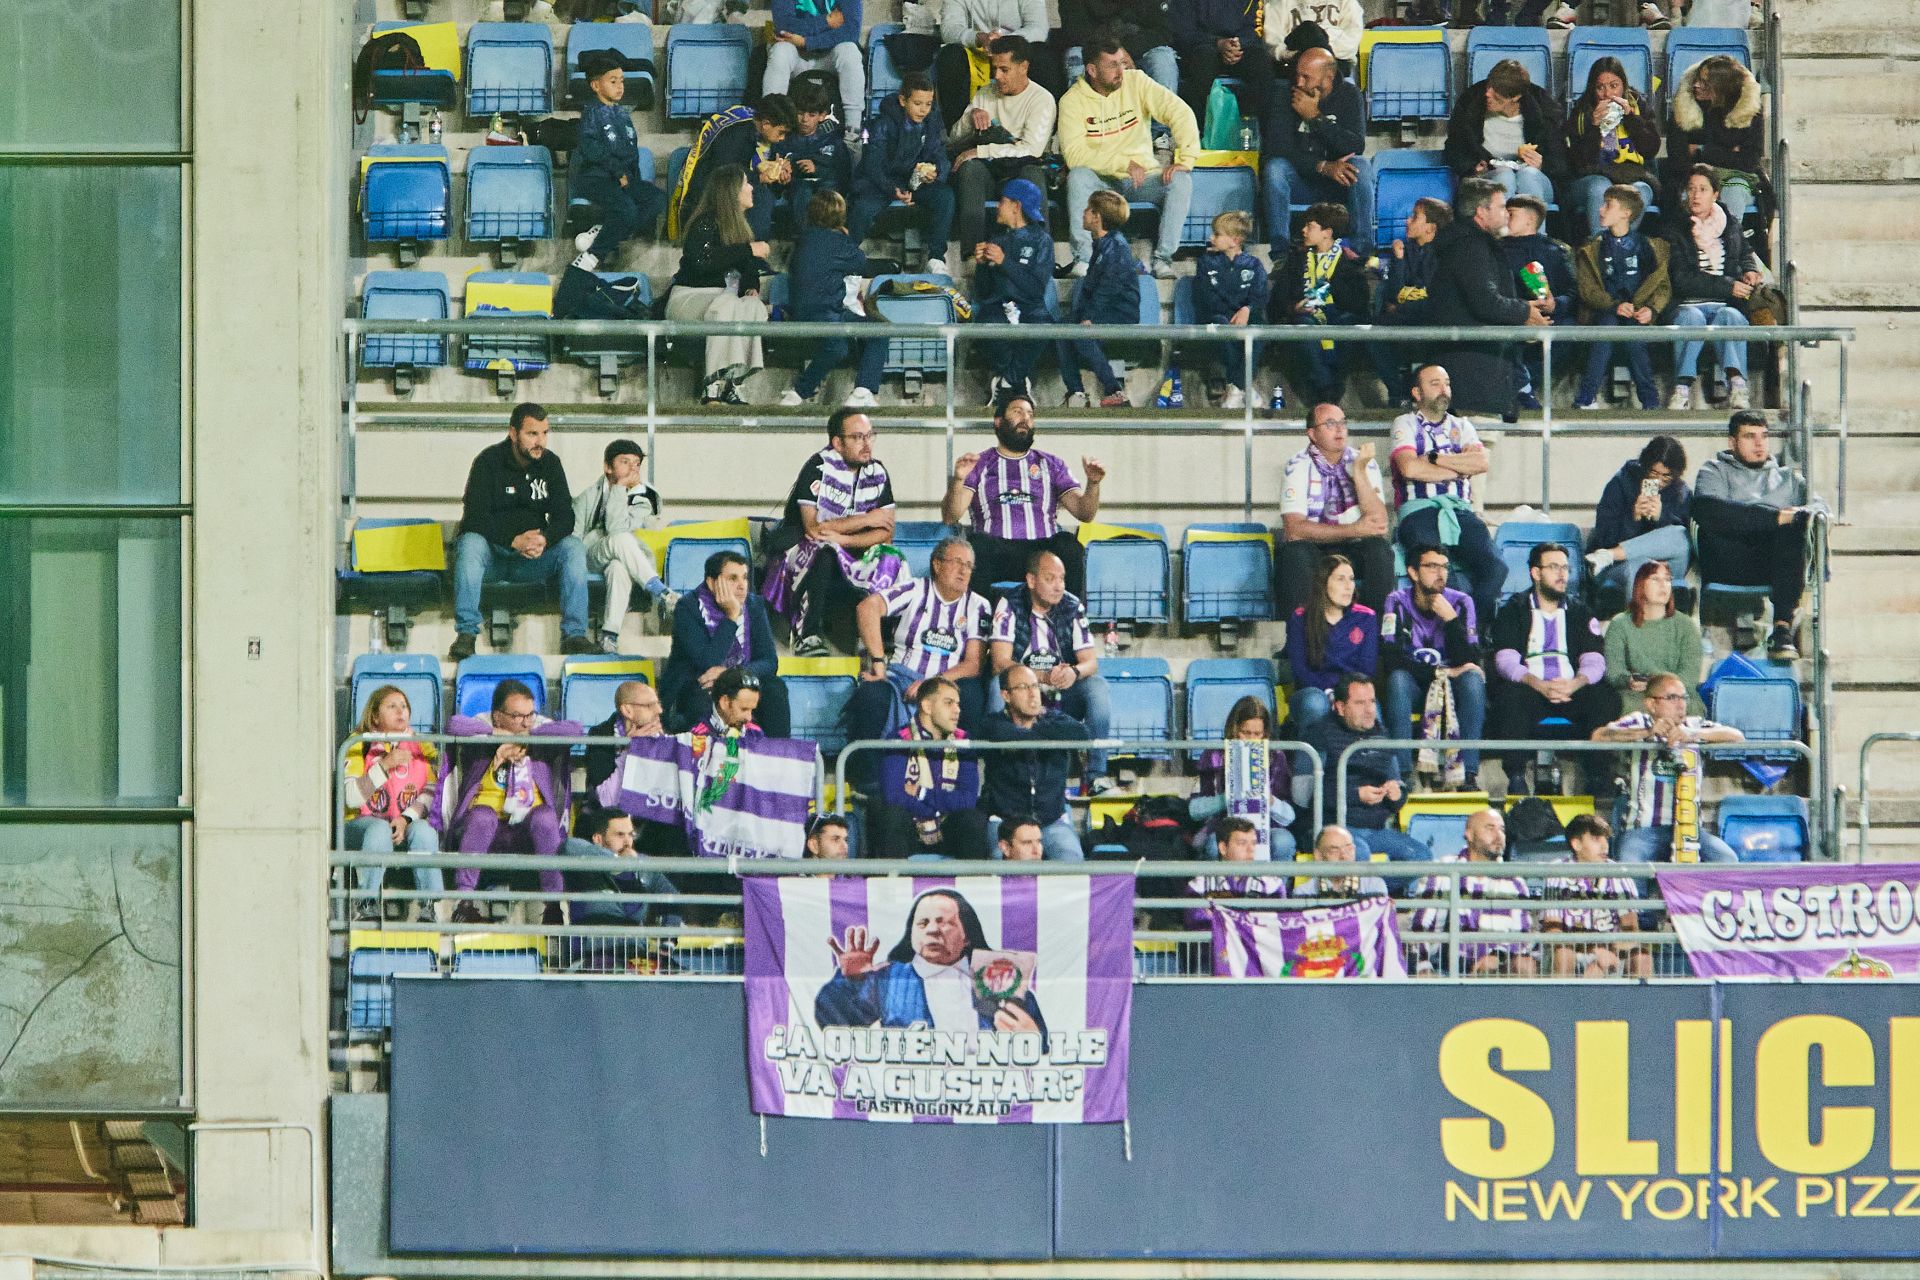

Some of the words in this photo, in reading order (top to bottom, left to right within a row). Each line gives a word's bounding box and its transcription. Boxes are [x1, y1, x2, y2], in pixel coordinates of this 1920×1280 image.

[530, 478, 548, 500] NY
[1030, 654, 1056, 663] Estrella
[1701, 879, 1920, 941] CASTRO
[766, 1024, 818, 1060] ¿A
[824, 1021, 968, 1066] QUIÉN
[976, 1031, 1041, 1067] NO
[1049, 1030, 1106, 1066] LE
[778, 1060, 837, 1098] VA
[842, 1065, 876, 1101] A
[883, 1066, 1084, 1103] GUSTAR?
[856, 1099, 1011, 1117] CASTROGONZALO
[1445, 1179, 1592, 1222] NEW
[1606, 1177, 1781, 1221] YORK
[1796, 1175, 1920, 1217] PIZZ
